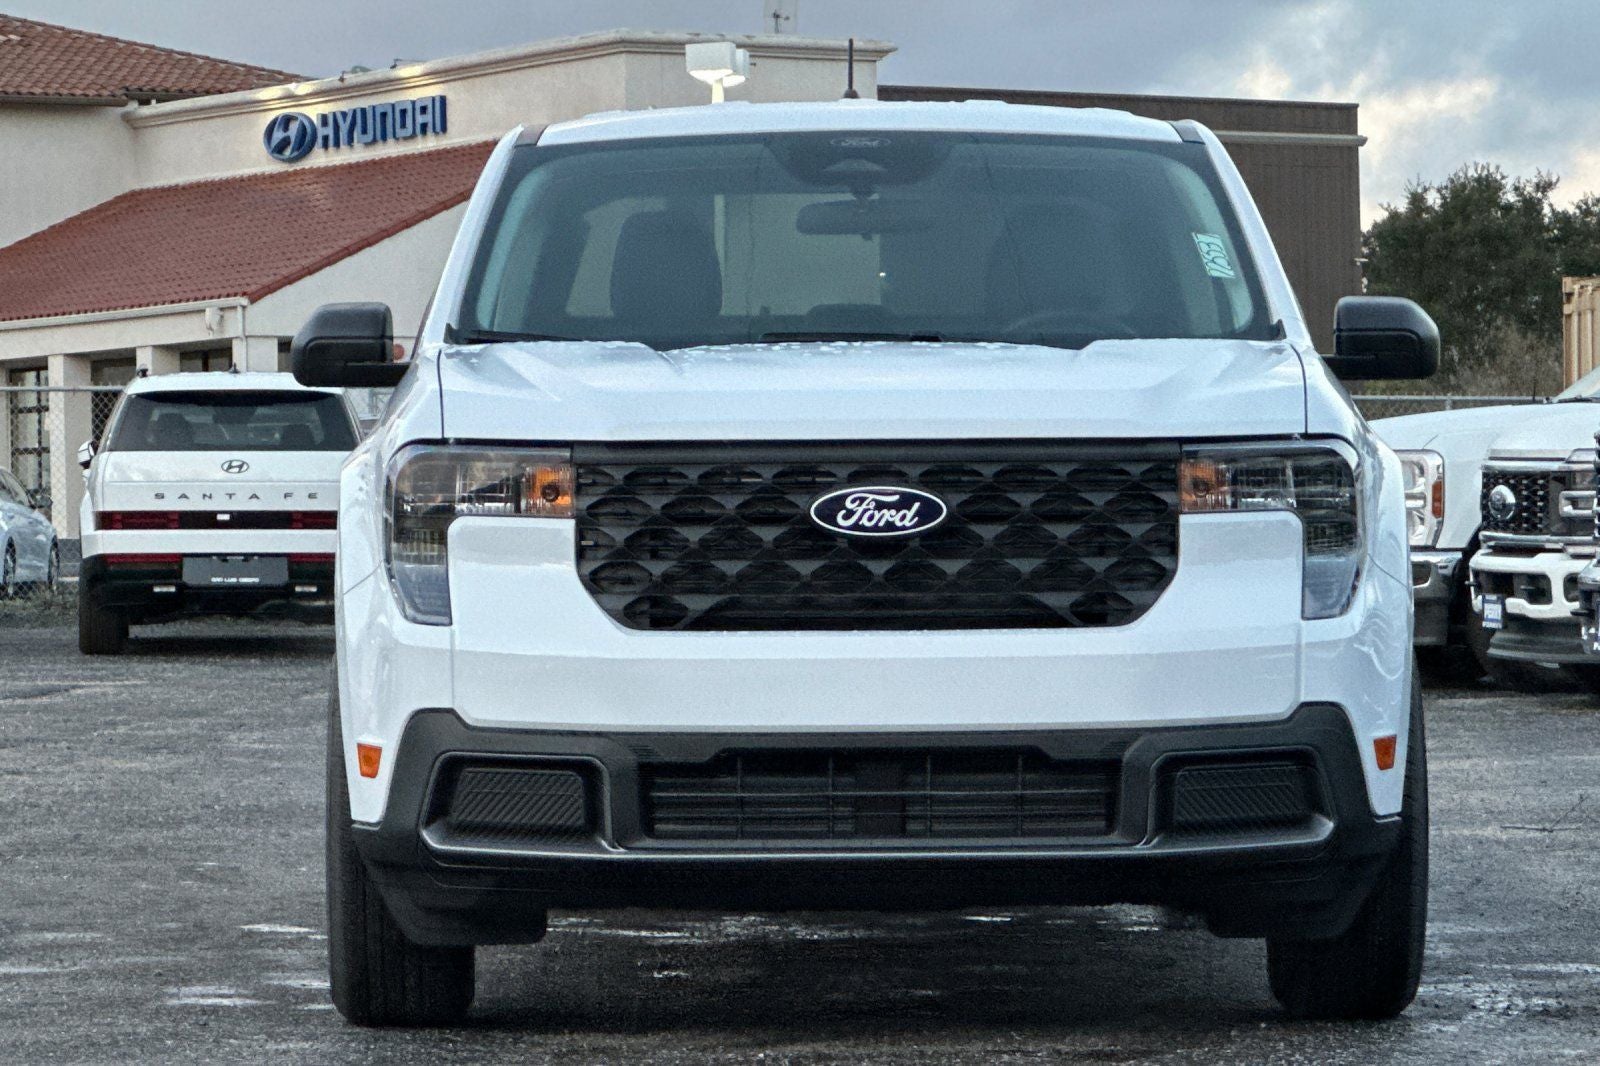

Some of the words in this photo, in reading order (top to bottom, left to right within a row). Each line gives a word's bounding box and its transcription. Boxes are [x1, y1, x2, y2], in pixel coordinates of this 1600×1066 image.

[316, 95, 447, 150] HYUNDAI
[154, 492, 261, 500] SANTA
[283, 492, 319, 500] FE
[836, 492, 921, 527] Ford
